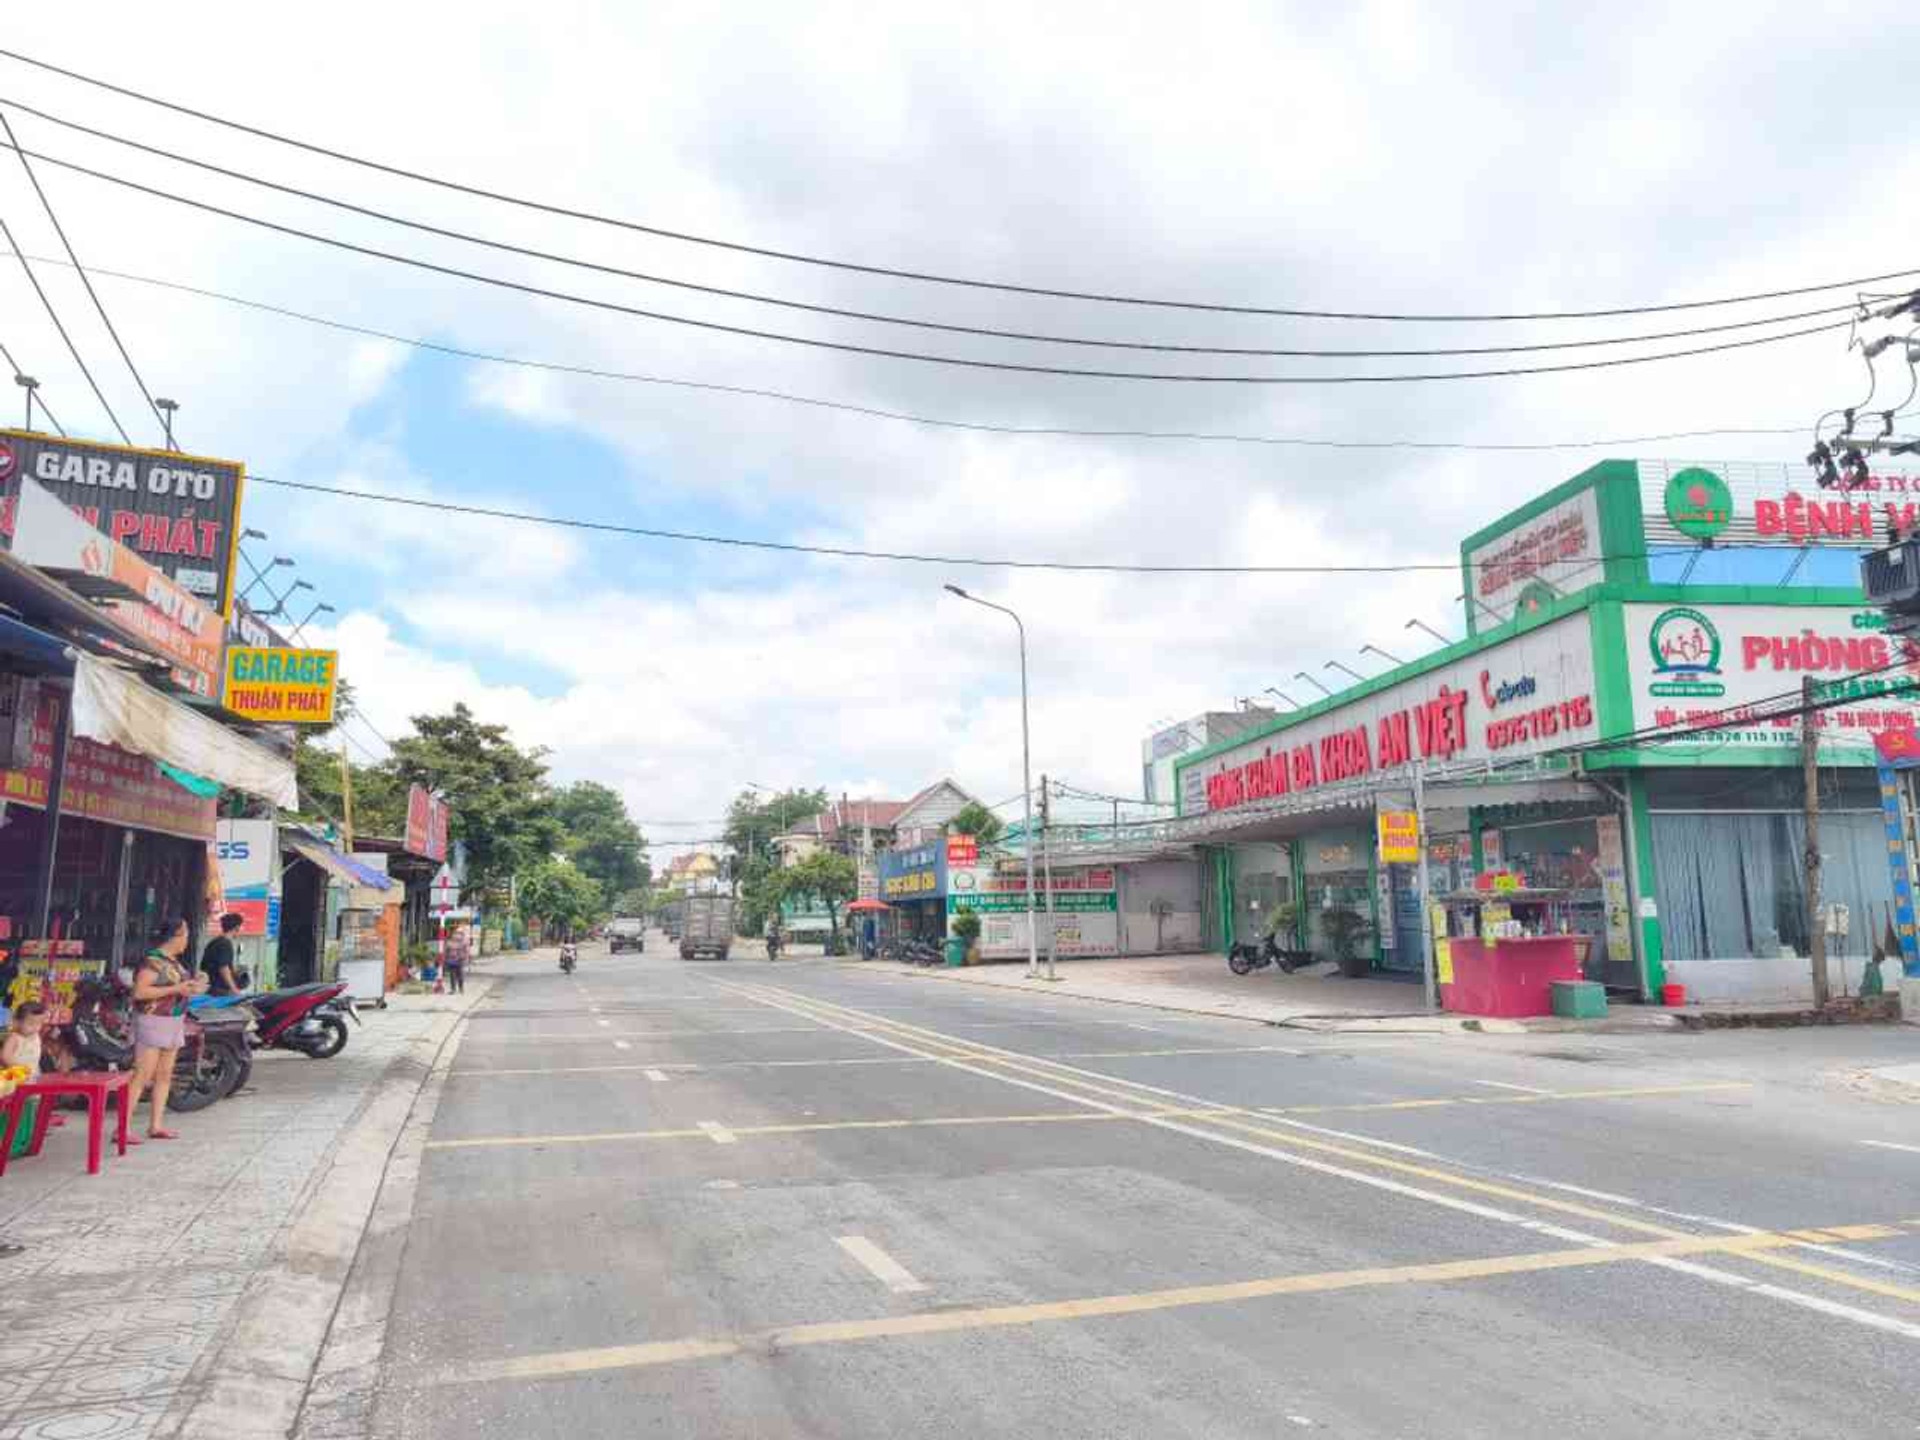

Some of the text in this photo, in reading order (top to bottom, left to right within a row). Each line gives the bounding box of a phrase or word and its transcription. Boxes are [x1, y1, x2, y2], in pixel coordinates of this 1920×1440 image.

[36, 451, 137, 491] GARA
[112, 505, 221, 560] PHÁT
[234, 653, 329, 686] GARAGE
[1741, 629, 1889, 672] PHÒNG
[1320, 722, 1373, 784] KHOA
[1378, 707, 1411, 769] AN
[1414, 684, 1468, 762] VIỆT
